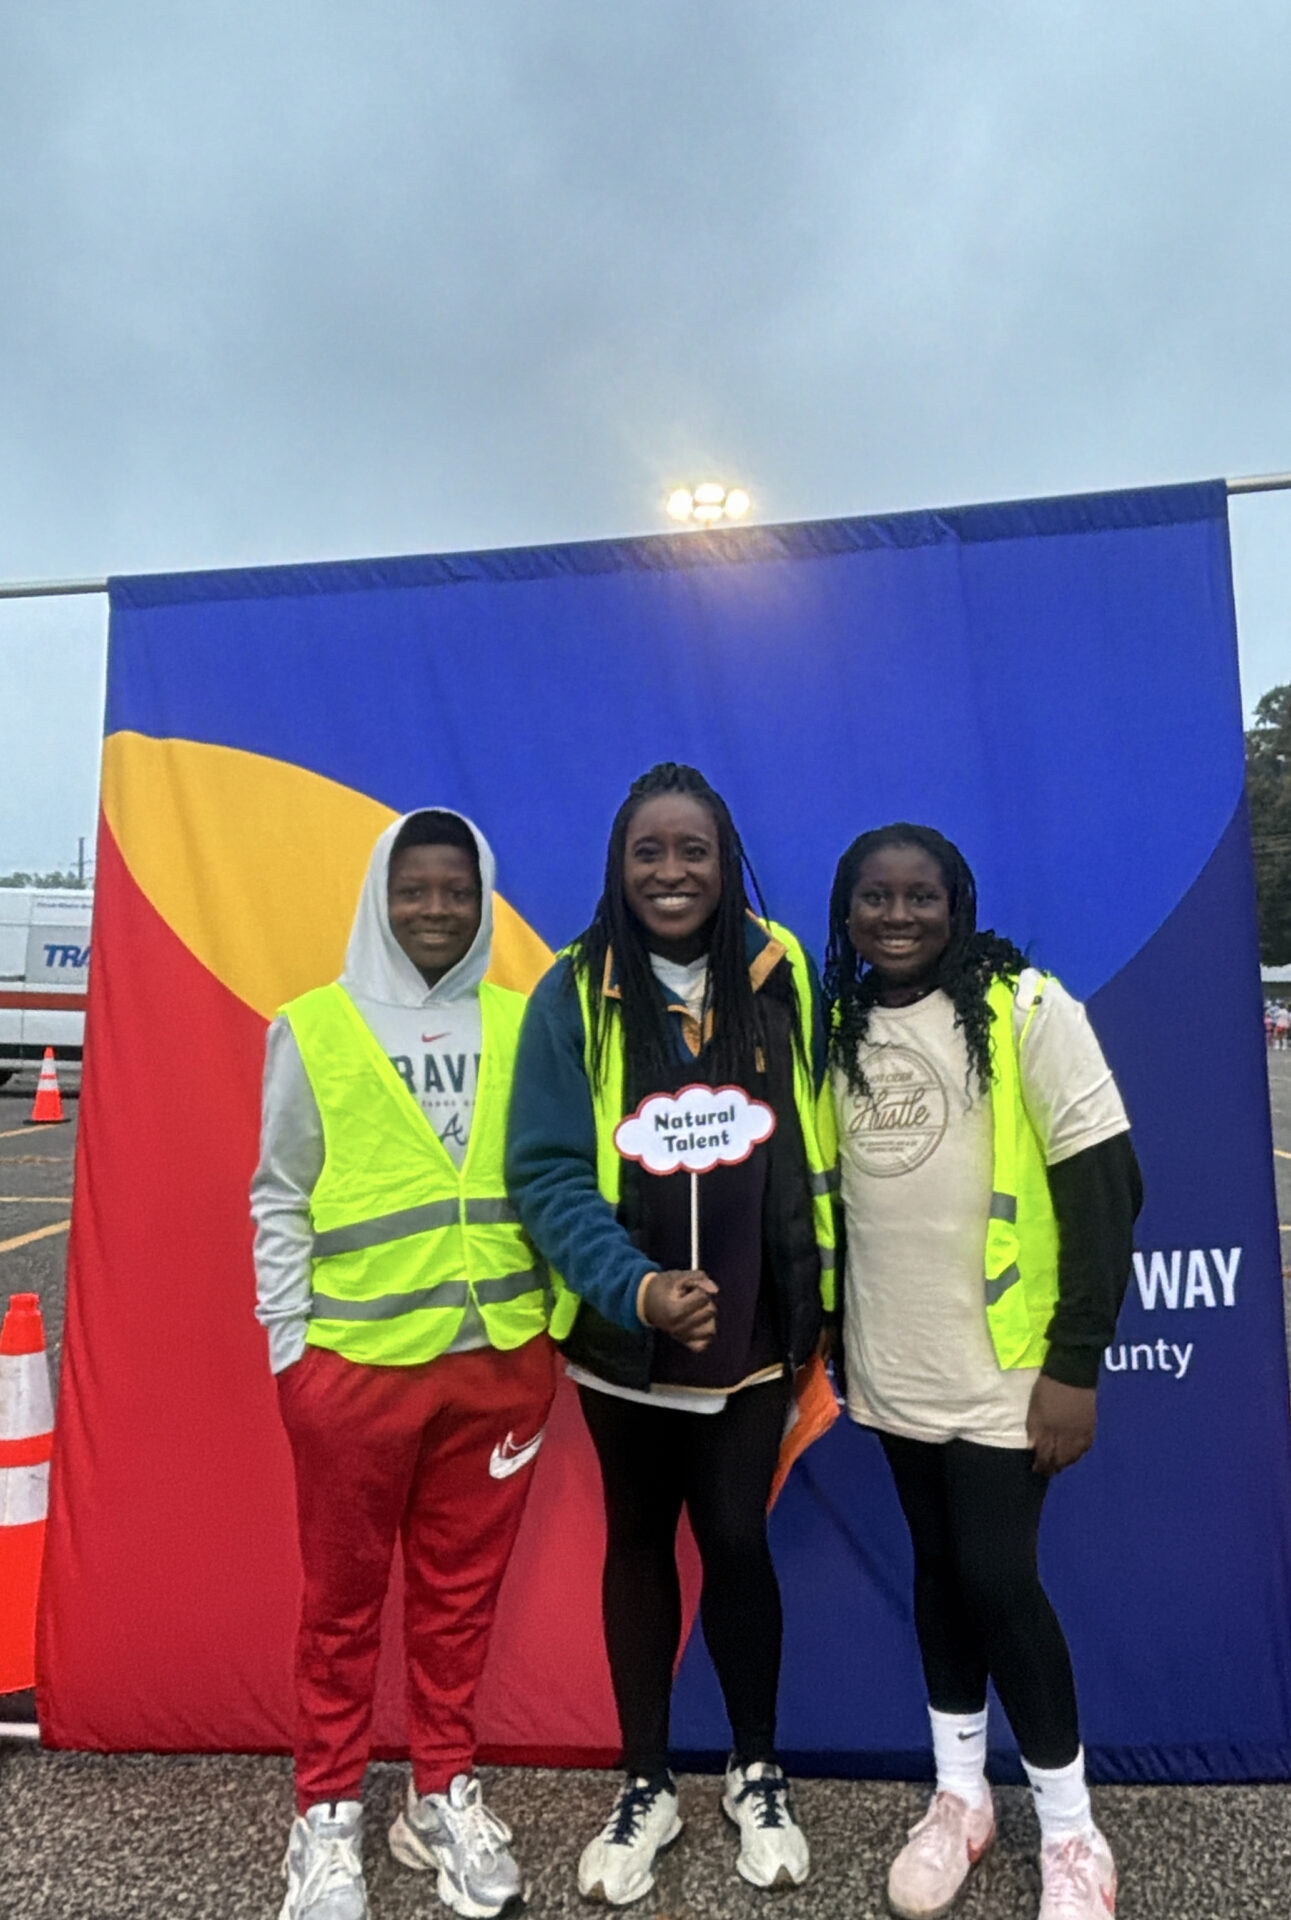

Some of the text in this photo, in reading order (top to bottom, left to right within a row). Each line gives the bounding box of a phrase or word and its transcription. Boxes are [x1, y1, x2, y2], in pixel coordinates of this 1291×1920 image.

[654, 1105, 736, 1132] Natural
[849, 1086, 931, 1135] Hustle
[663, 1130, 730, 1153] Talent
[1132, 1247, 1242, 1310] WAY
[1104, 1338, 1194, 1379] unty
